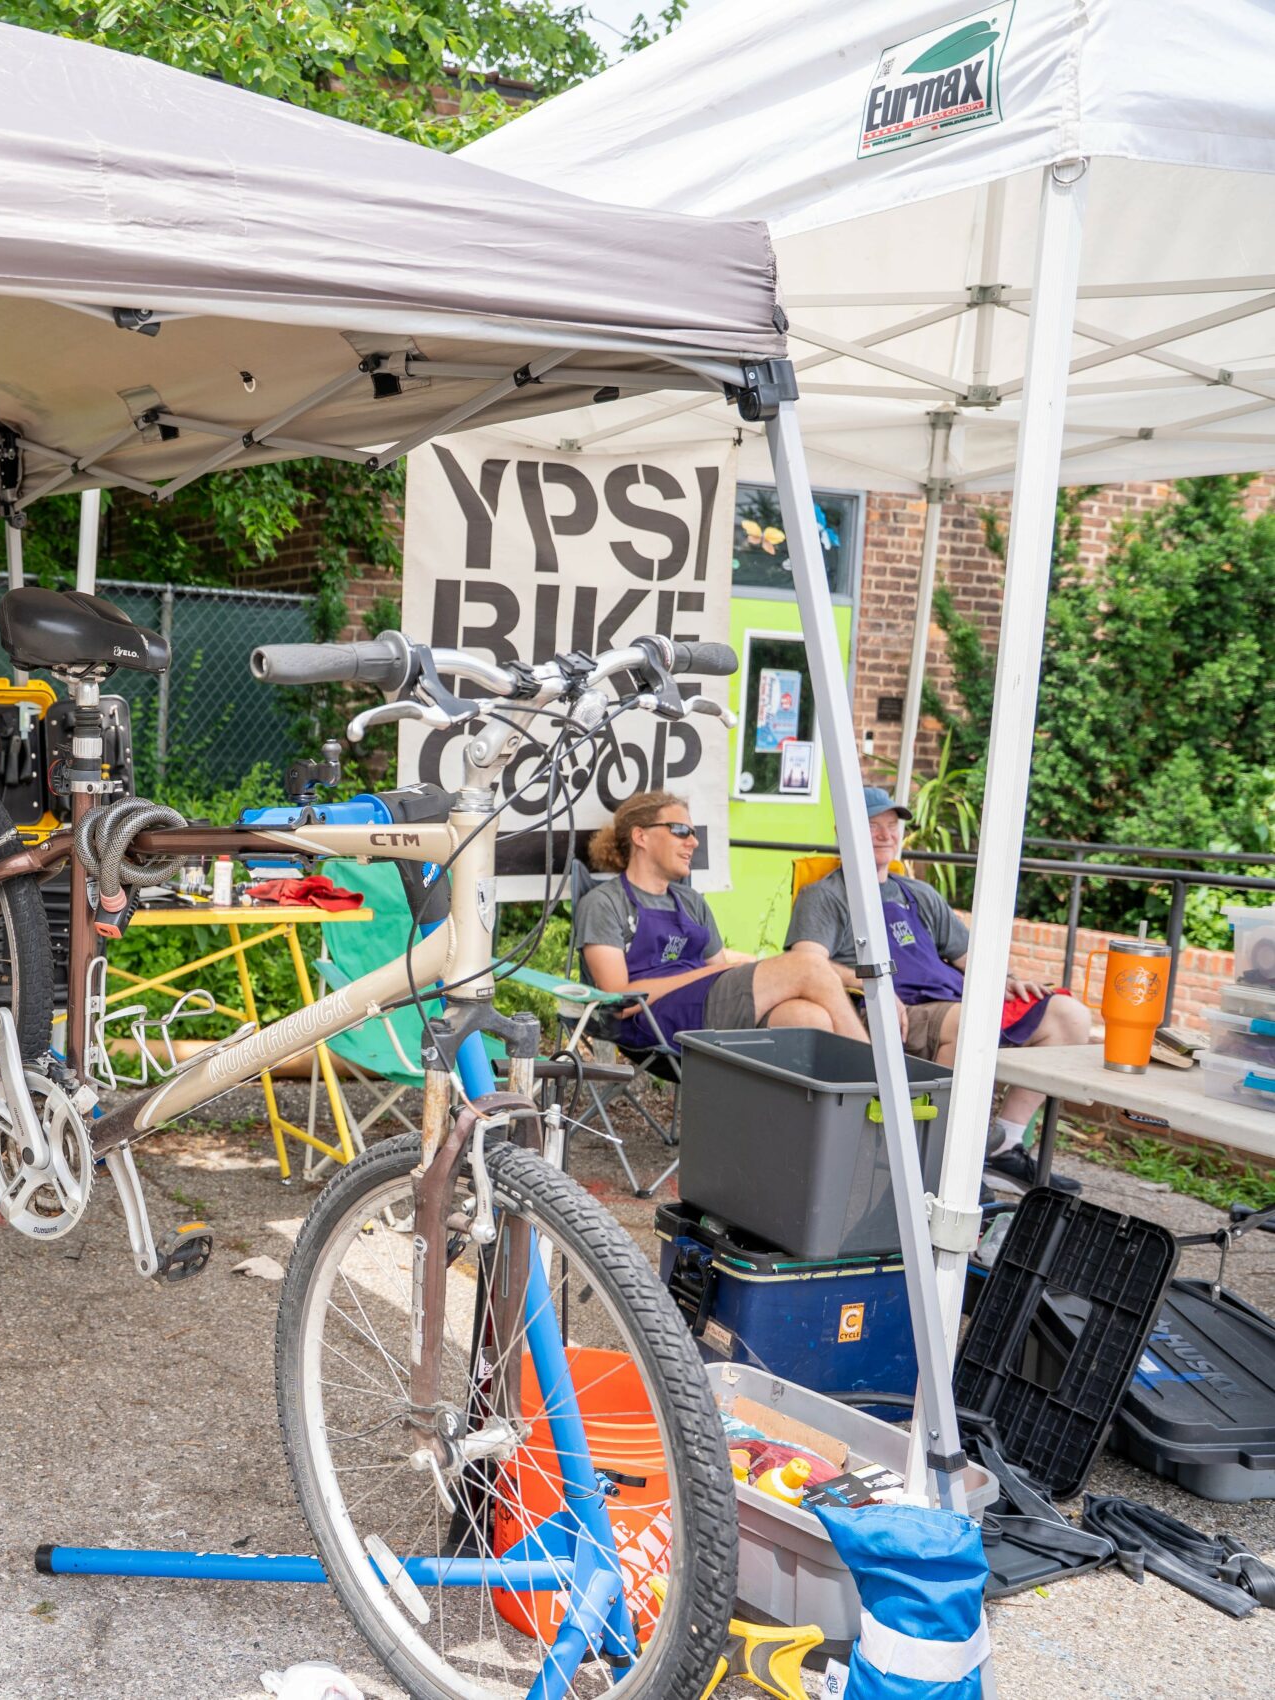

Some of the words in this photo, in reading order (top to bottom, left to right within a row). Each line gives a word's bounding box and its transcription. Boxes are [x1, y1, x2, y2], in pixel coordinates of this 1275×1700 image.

[865, 60, 984, 132] Eurmax
[911, 113, 944, 126] EURMAX
[946, 103, 982, 116] CANOPY
[431, 442, 719, 581] YPSI
[430, 578, 705, 702] BIKE
[370, 833, 420, 847] CTM
[839, 1331, 861, 1340] CYCLE
[1149, 1333, 1253, 1400] HUSKY
